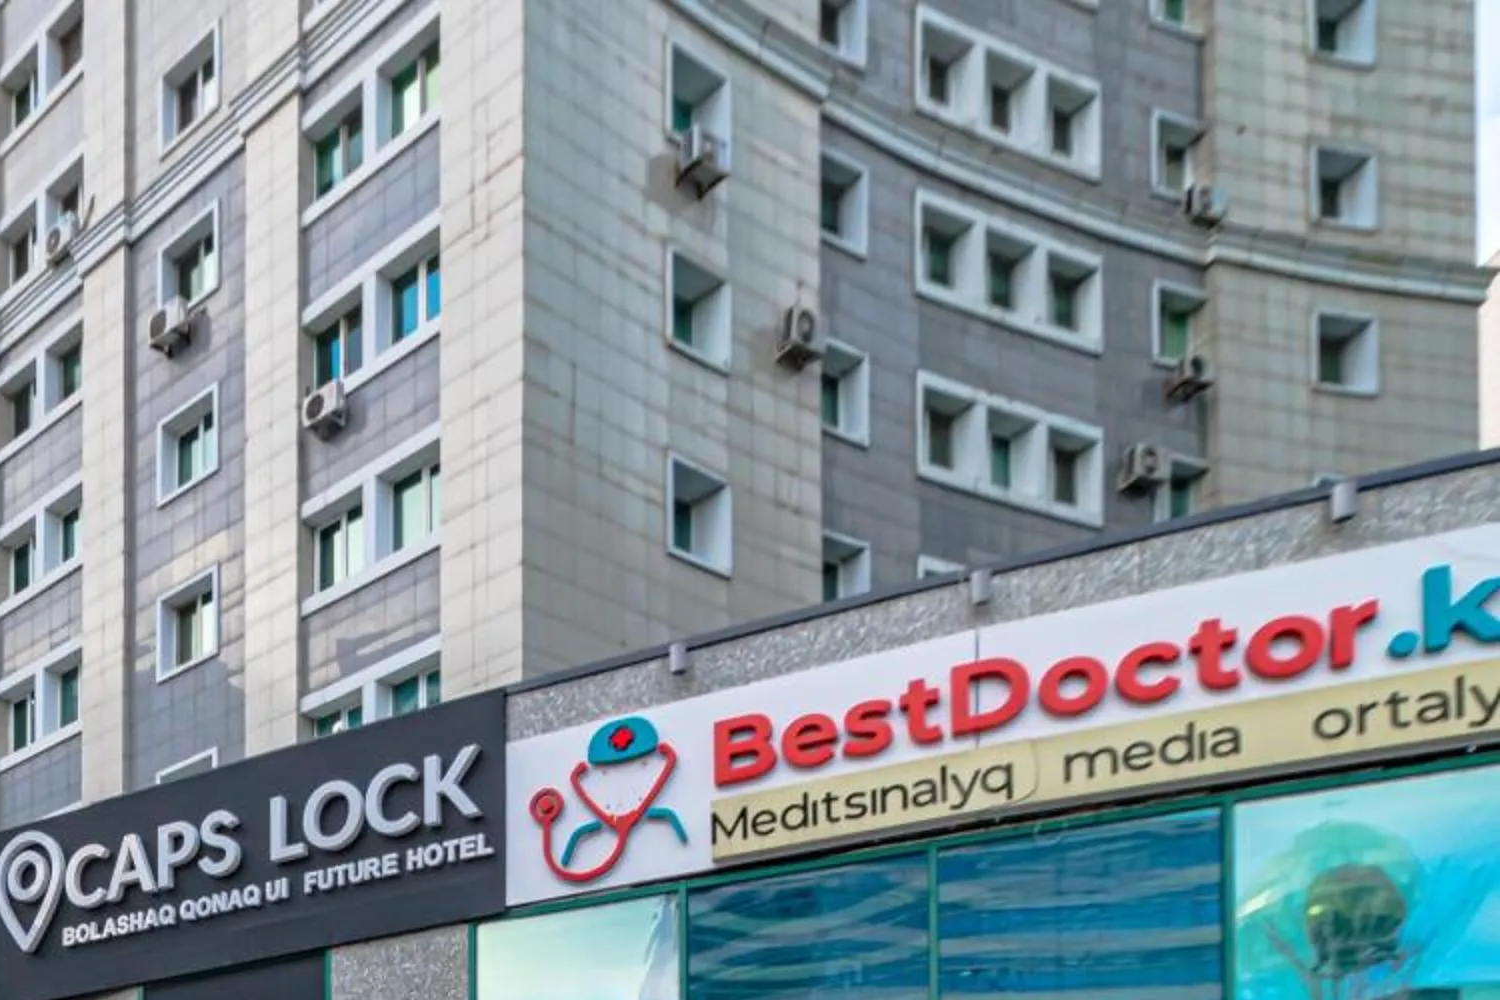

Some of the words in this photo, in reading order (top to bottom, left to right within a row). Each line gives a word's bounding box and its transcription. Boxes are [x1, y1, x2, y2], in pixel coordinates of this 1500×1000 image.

[62, 903, 176, 948] BOLASHAQ
[179, 882, 261, 922] QONAQ
[265, 877, 290, 903] UI
[303, 852, 399, 895] FUTURE
[405, 832, 495, 873] HOTEL
[65, 808, 243, 910] CAPS
[269, 743, 485, 863] LOCK
